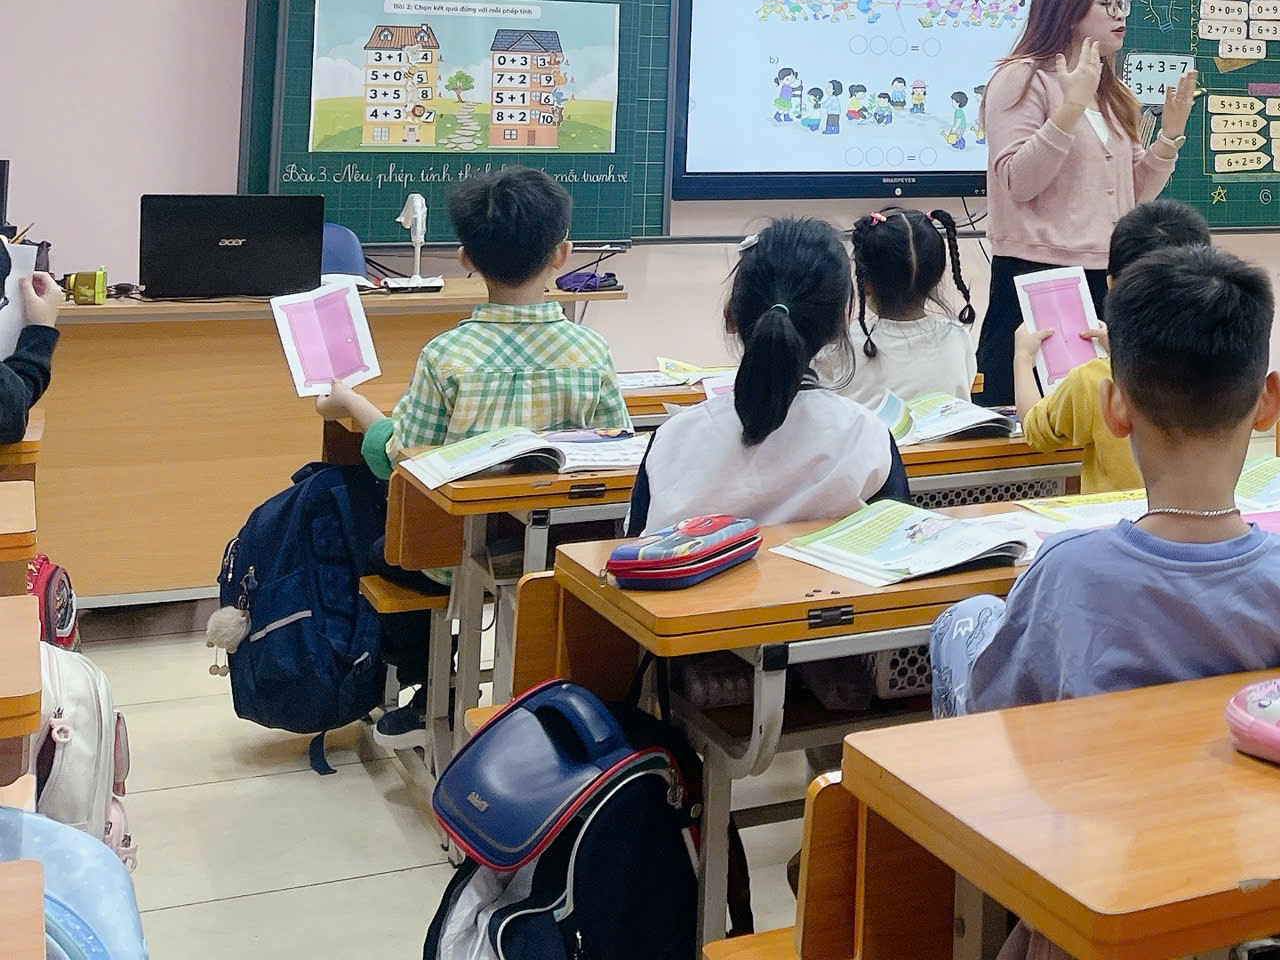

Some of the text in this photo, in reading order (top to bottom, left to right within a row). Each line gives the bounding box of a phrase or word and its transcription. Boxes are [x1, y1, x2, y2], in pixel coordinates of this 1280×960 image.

[1135, 60, 1144, 73] 4
[1158, 61, 1165, 73] 3
[1180, 62, 1188, 73] 7
[1135, 83, 1143, 95] 3
[1157, 83, 1165, 96] 4
[282, 163, 315, 182] Bài
[333, 163, 372, 182] Nêu
[376, 163, 416, 189] phép
[421, 163, 453, 182] tính
[582, 164, 617, 183] tranh
[219, 238, 247, 246] acer
